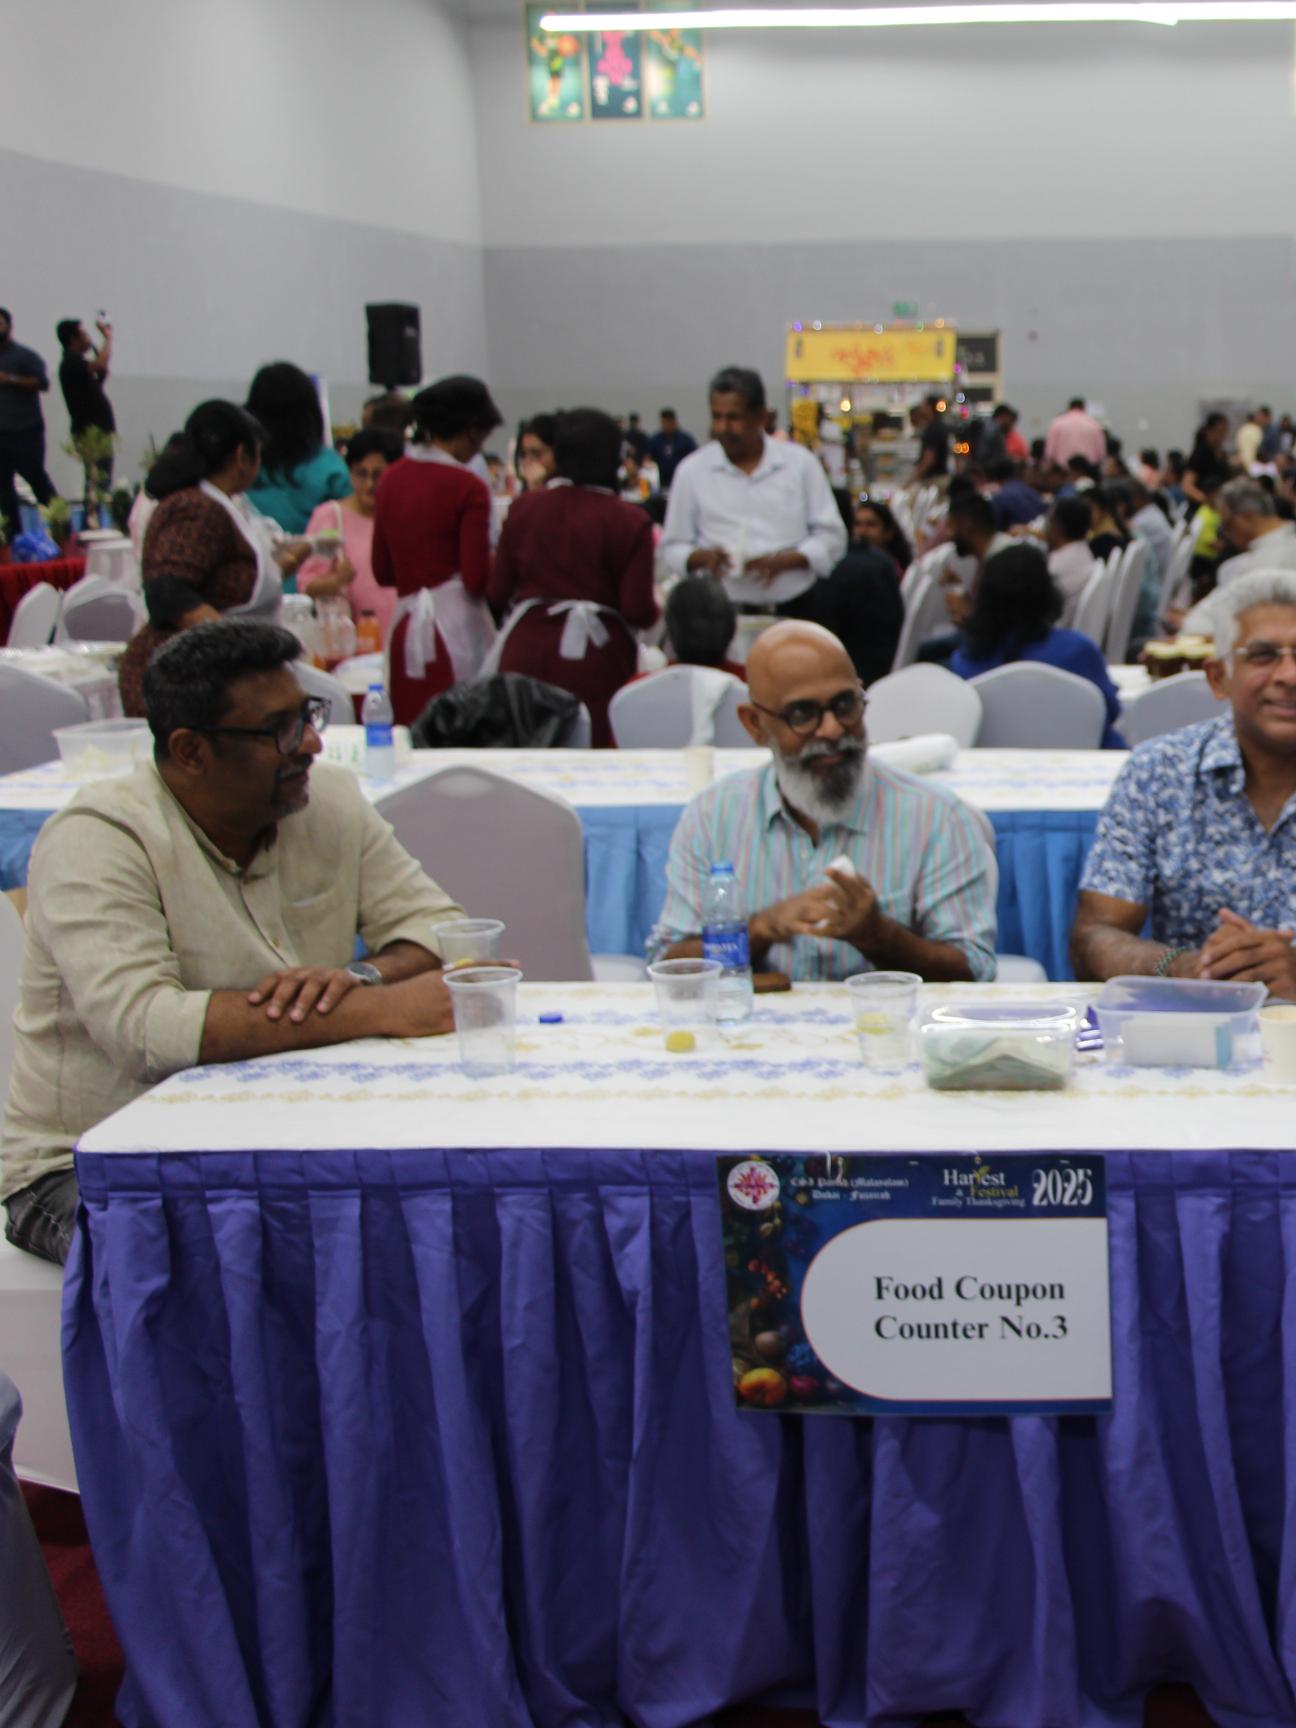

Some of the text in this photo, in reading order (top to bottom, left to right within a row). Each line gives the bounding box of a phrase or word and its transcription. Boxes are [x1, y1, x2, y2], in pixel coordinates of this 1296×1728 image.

[943, 1167, 1005, 1186] Harvest
[1032, 1168, 1093, 1206] 2025
[931, 1196, 1026, 1208] Family Thanksgiving
[969, 1185, 1019, 1198] Festival
[874, 1275, 1066, 1307] Food Coupon
[874, 1314, 1068, 1341] Counter No.3
